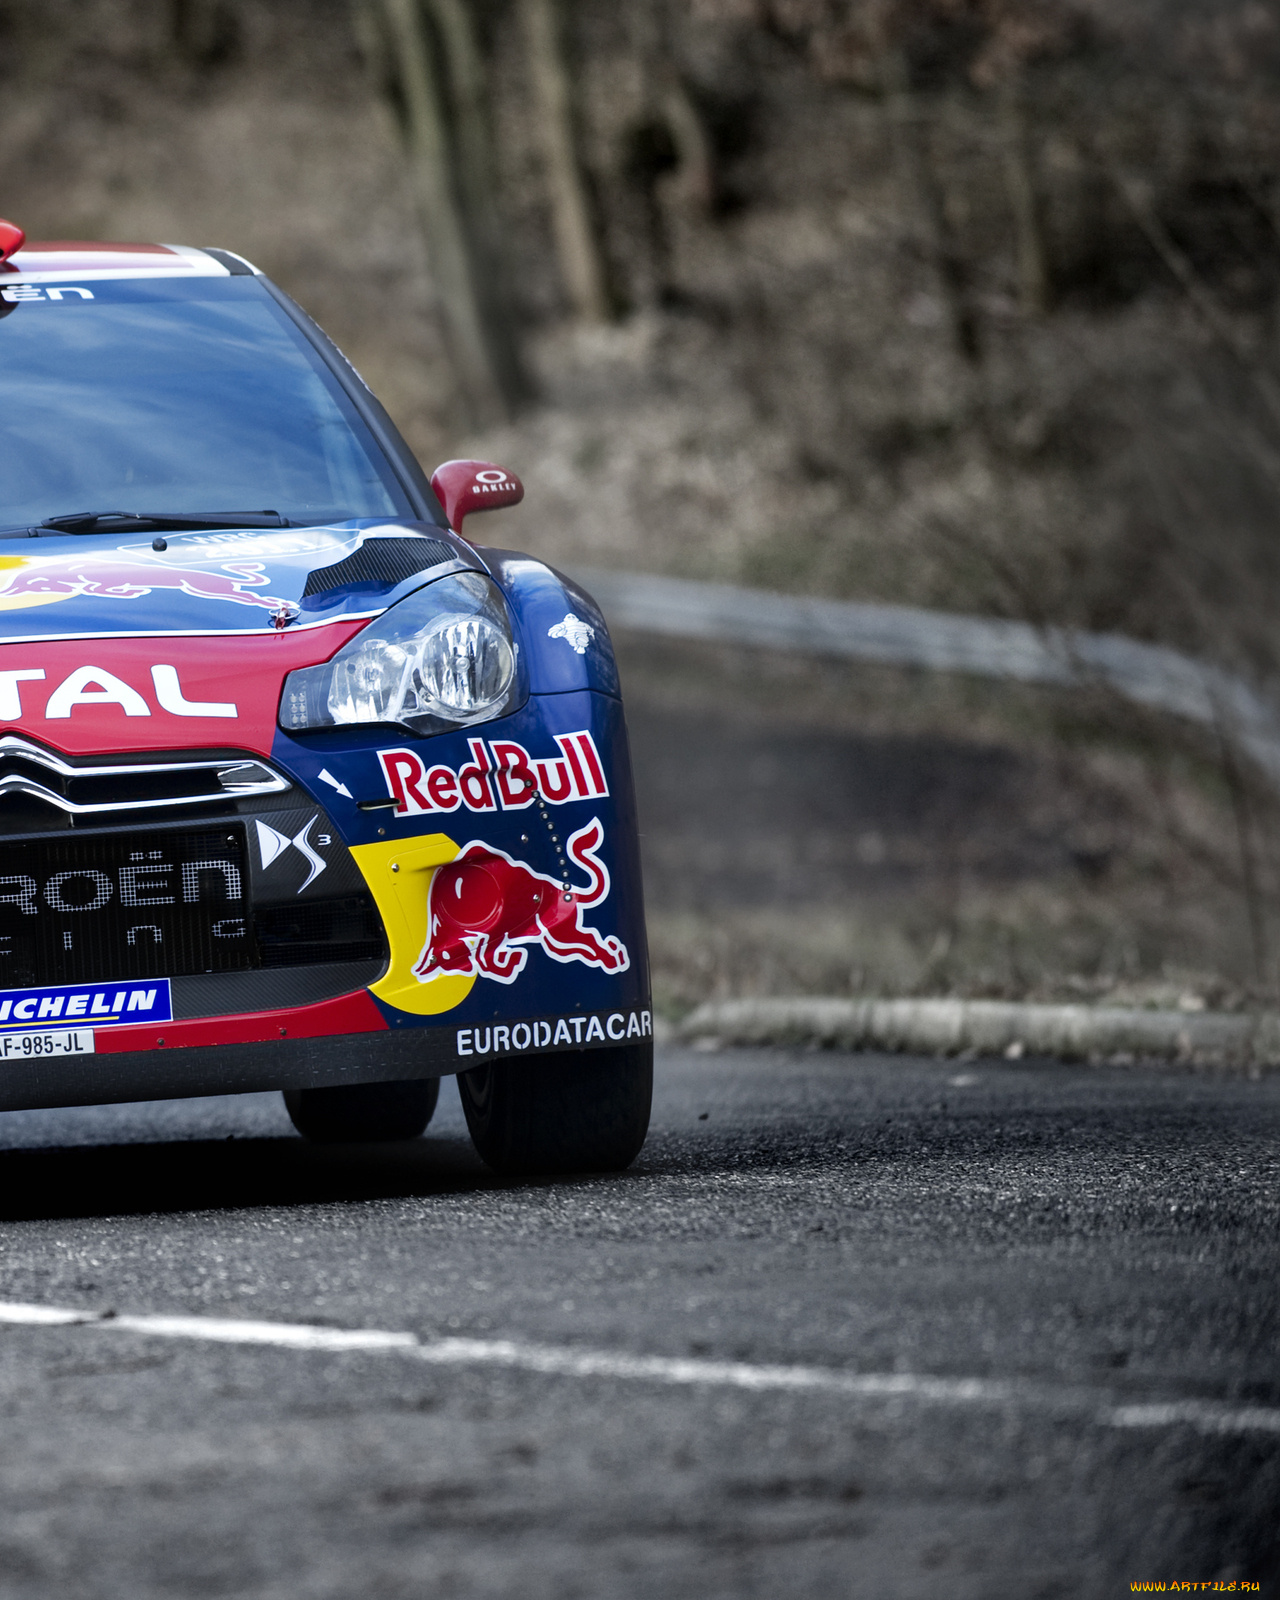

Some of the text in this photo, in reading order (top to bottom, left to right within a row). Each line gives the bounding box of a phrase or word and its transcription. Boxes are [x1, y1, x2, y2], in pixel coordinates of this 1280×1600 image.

[472, 483, 516, 494] OAKLEY
[181, 532, 266, 545] WRC
[456, 1010, 652, 1056] EURODATACAR
